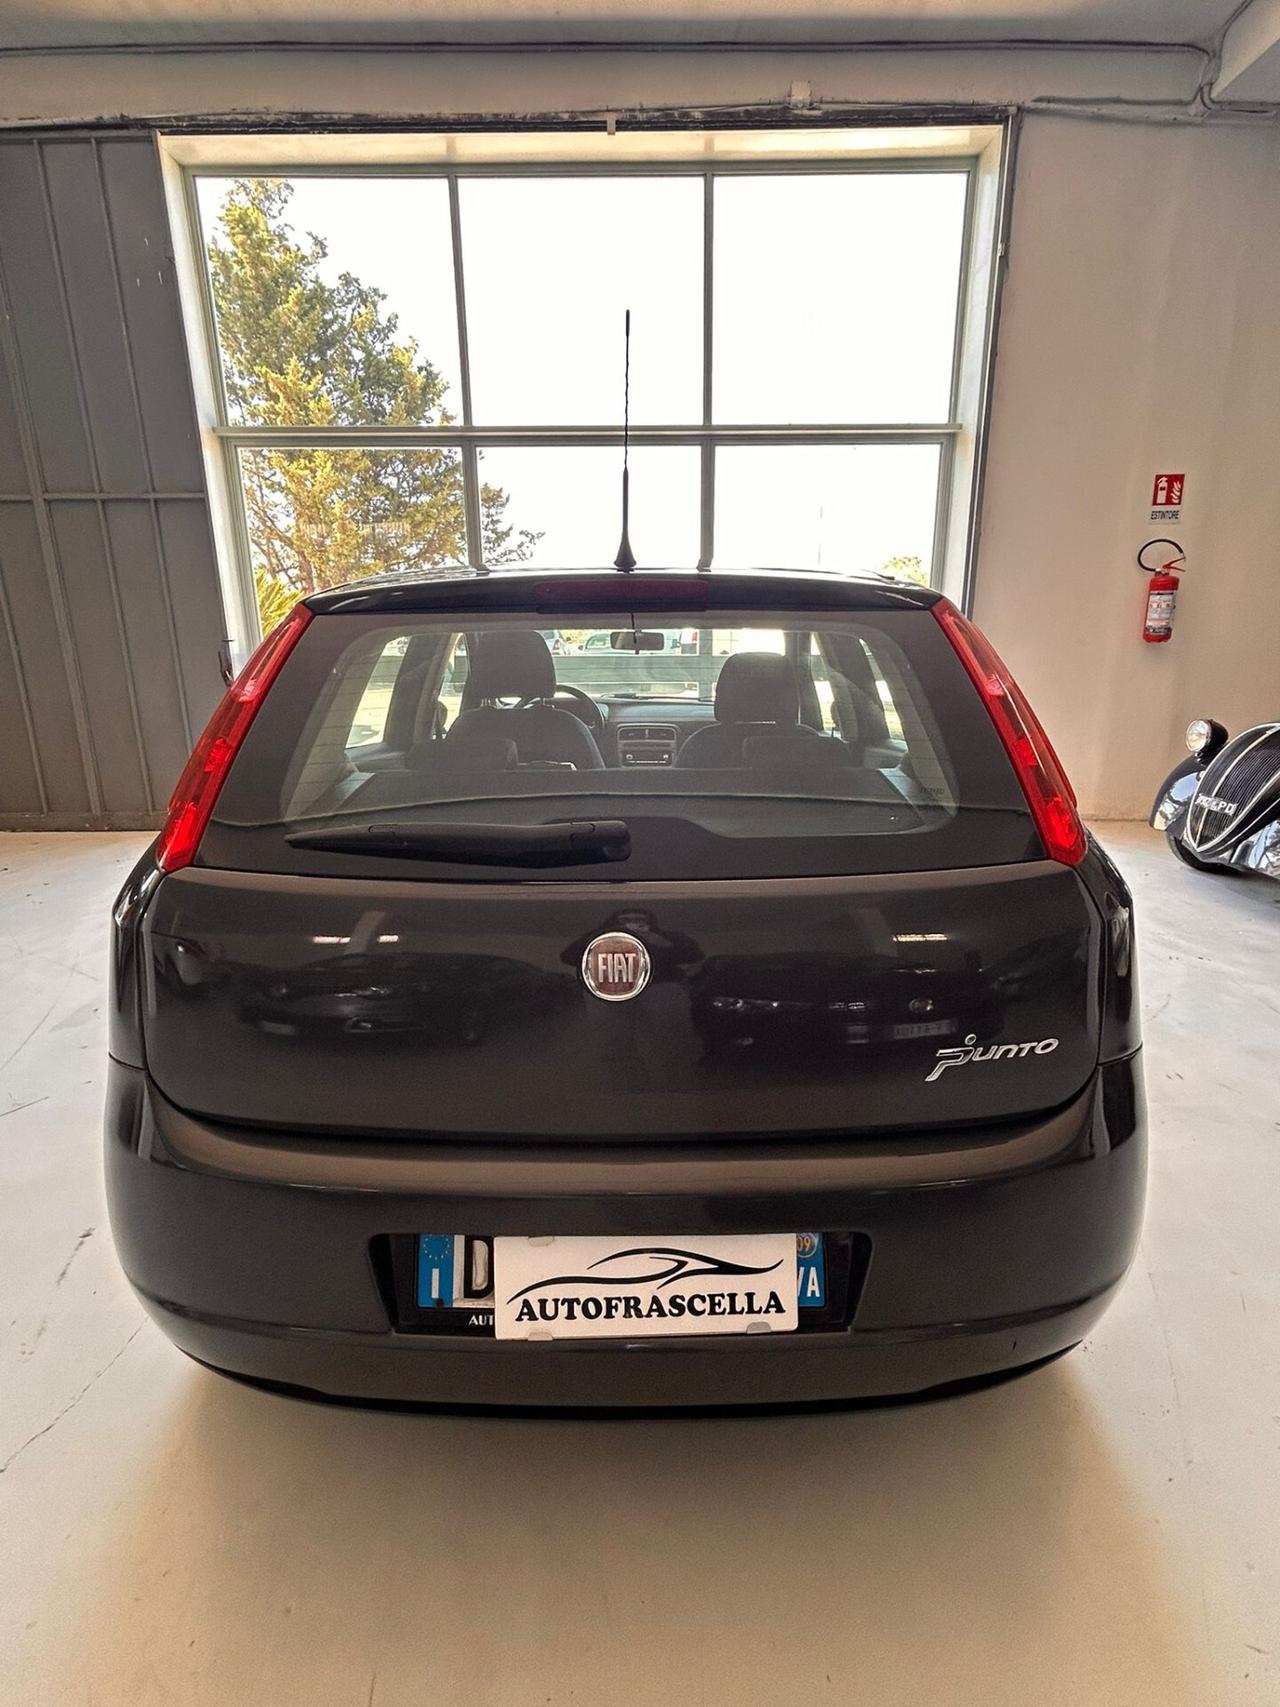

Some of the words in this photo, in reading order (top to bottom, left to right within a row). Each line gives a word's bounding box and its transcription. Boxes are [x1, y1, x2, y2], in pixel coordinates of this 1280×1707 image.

[1150, 510, 1180, 520] ESTINTORE
[598, 953, 636, 983] FIAT
[515, 1291, 786, 1321] AUTOFRASCELLA
